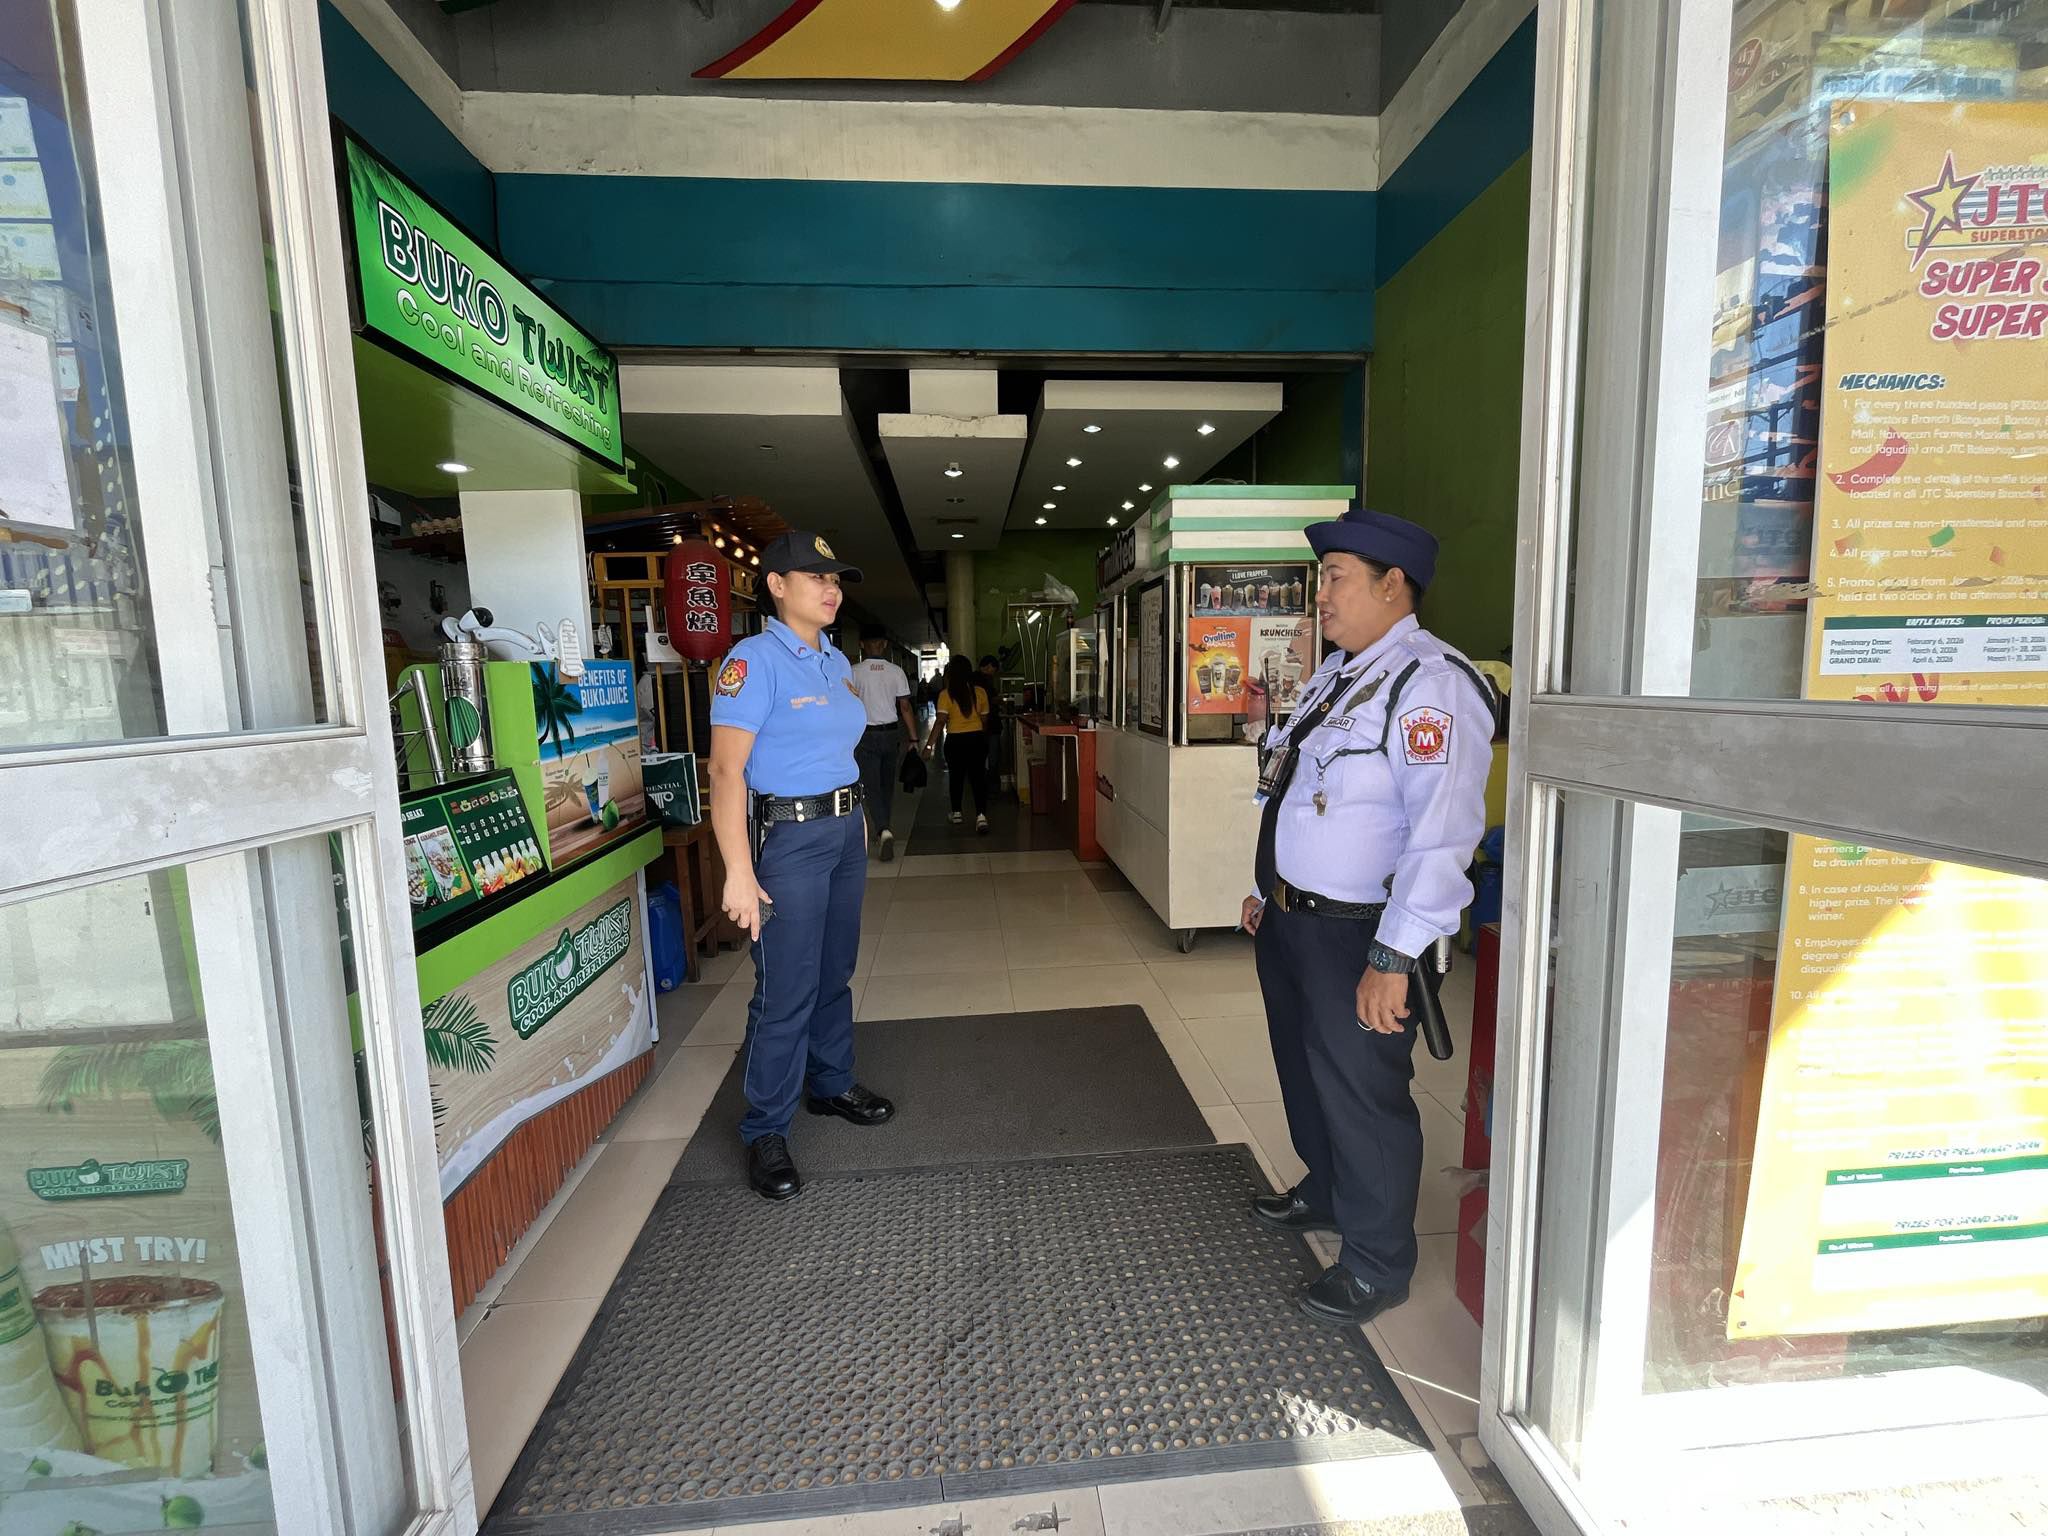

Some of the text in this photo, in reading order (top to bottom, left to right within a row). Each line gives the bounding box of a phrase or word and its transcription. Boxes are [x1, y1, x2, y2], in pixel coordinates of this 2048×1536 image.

[1921, 260, 2041, 295] SUPER
[378, 200, 609, 415] BUKO TWIST
[1931, 303, 2048, 338] SUPER
[397, 288, 612, 451] Cool and Refreshing
[1839, 374, 1946, 390] MECHANICS:
[1874, 402, 1899, 412] every
[1904, 400, 1932, 409] three
[1937, 399, 1976, 409] hundred
[1850, 445, 1872, 454] and
[1875, 445, 1917, 456] Tagudin)
[1948, 445, 1965, 454] JTC
[1836, 475, 1845, 485] 2.
[1850, 475, 1899, 486] Complete
[1903, 489, 1917, 498] all
[1920, 489, 1941, 498] JTC
[1832, 520, 1841, 529] 3.
[1845, 520, 1861, 529] All
[1863, 520, 1894, 530] prizes
[1844, 549, 1858, 558] All
[1827, 577, 1836, 587] 5.
[1840, 577, 1875, 587] Promo
[1922, 577, 1945, 587] from
[1865, 592, 1877, 601] at
[1936, 592, 1946, 600] in
[1950, 591, 1967, 600] the
[1203, 631, 1237, 643] Ovaltine
[1830, 639, 1870, 648] Preliminary
[1830, 648, 1870, 657] Preliminary
[1829, 657, 1856, 665] GRAND
[1912, 657, 1926, 665] April
[578, 669, 627, 688] BENEFITS OF
[1404, 716, 1448, 731] MANCAR
[1416, 730, 1436, 747] M
[1406, 748, 1446, 762] SECURITY
[1815, 845, 1854, 854] winners
[1812, 856, 1909, 867] be drawn from the
[1811, 885, 1820, 894] In
[1823, 885, 1848, 894] case
[1850, 884, 1863, 893] of
[1864, 883, 1898, 893] double
[1808, 898, 1841, 909] higher
[1875, 897, 1893, 905] The
[1808, 912, 1844, 921] winner.
[574, 900, 630, 965] TWIST
[1805, 937, 1862, 949] Employees
[1801, 952, 1840, 963] degree
[520, 934, 630, 1032] COOL AND REFRESHING
[1791, 991, 1803, 1000] 10.
[1888, 1150, 1925, 1160] PRIZES
[102, 1161, 186, 1182] TWIST
[40, 1187, 71, 1197] COOL
[40, 1236, 207, 1270] MUST TRY!
